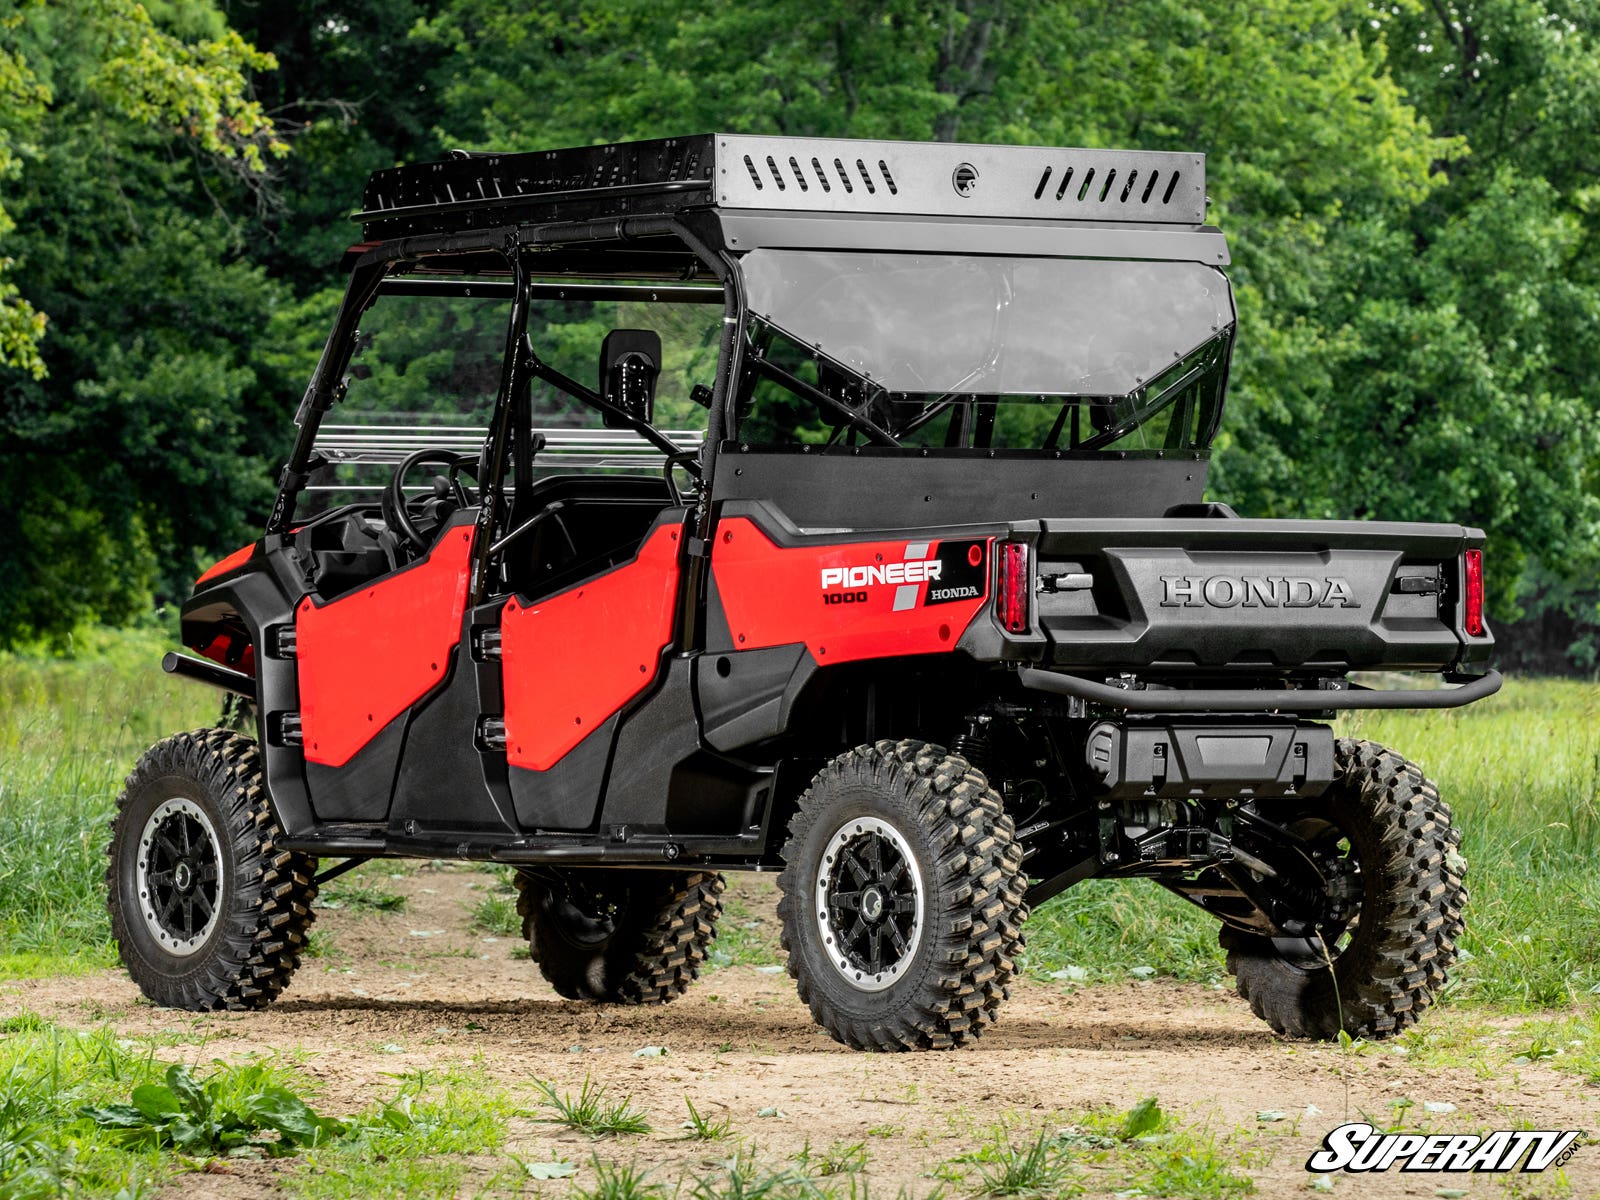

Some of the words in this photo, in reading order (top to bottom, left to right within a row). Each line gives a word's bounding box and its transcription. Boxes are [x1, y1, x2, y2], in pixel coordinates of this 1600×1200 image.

[821, 559, 942, 589] PIONEER
[823, 591, 868, 605] 1000
[931, 586, 979, 600] HONDA
[1160, 575, 1361, 608] HONDA
